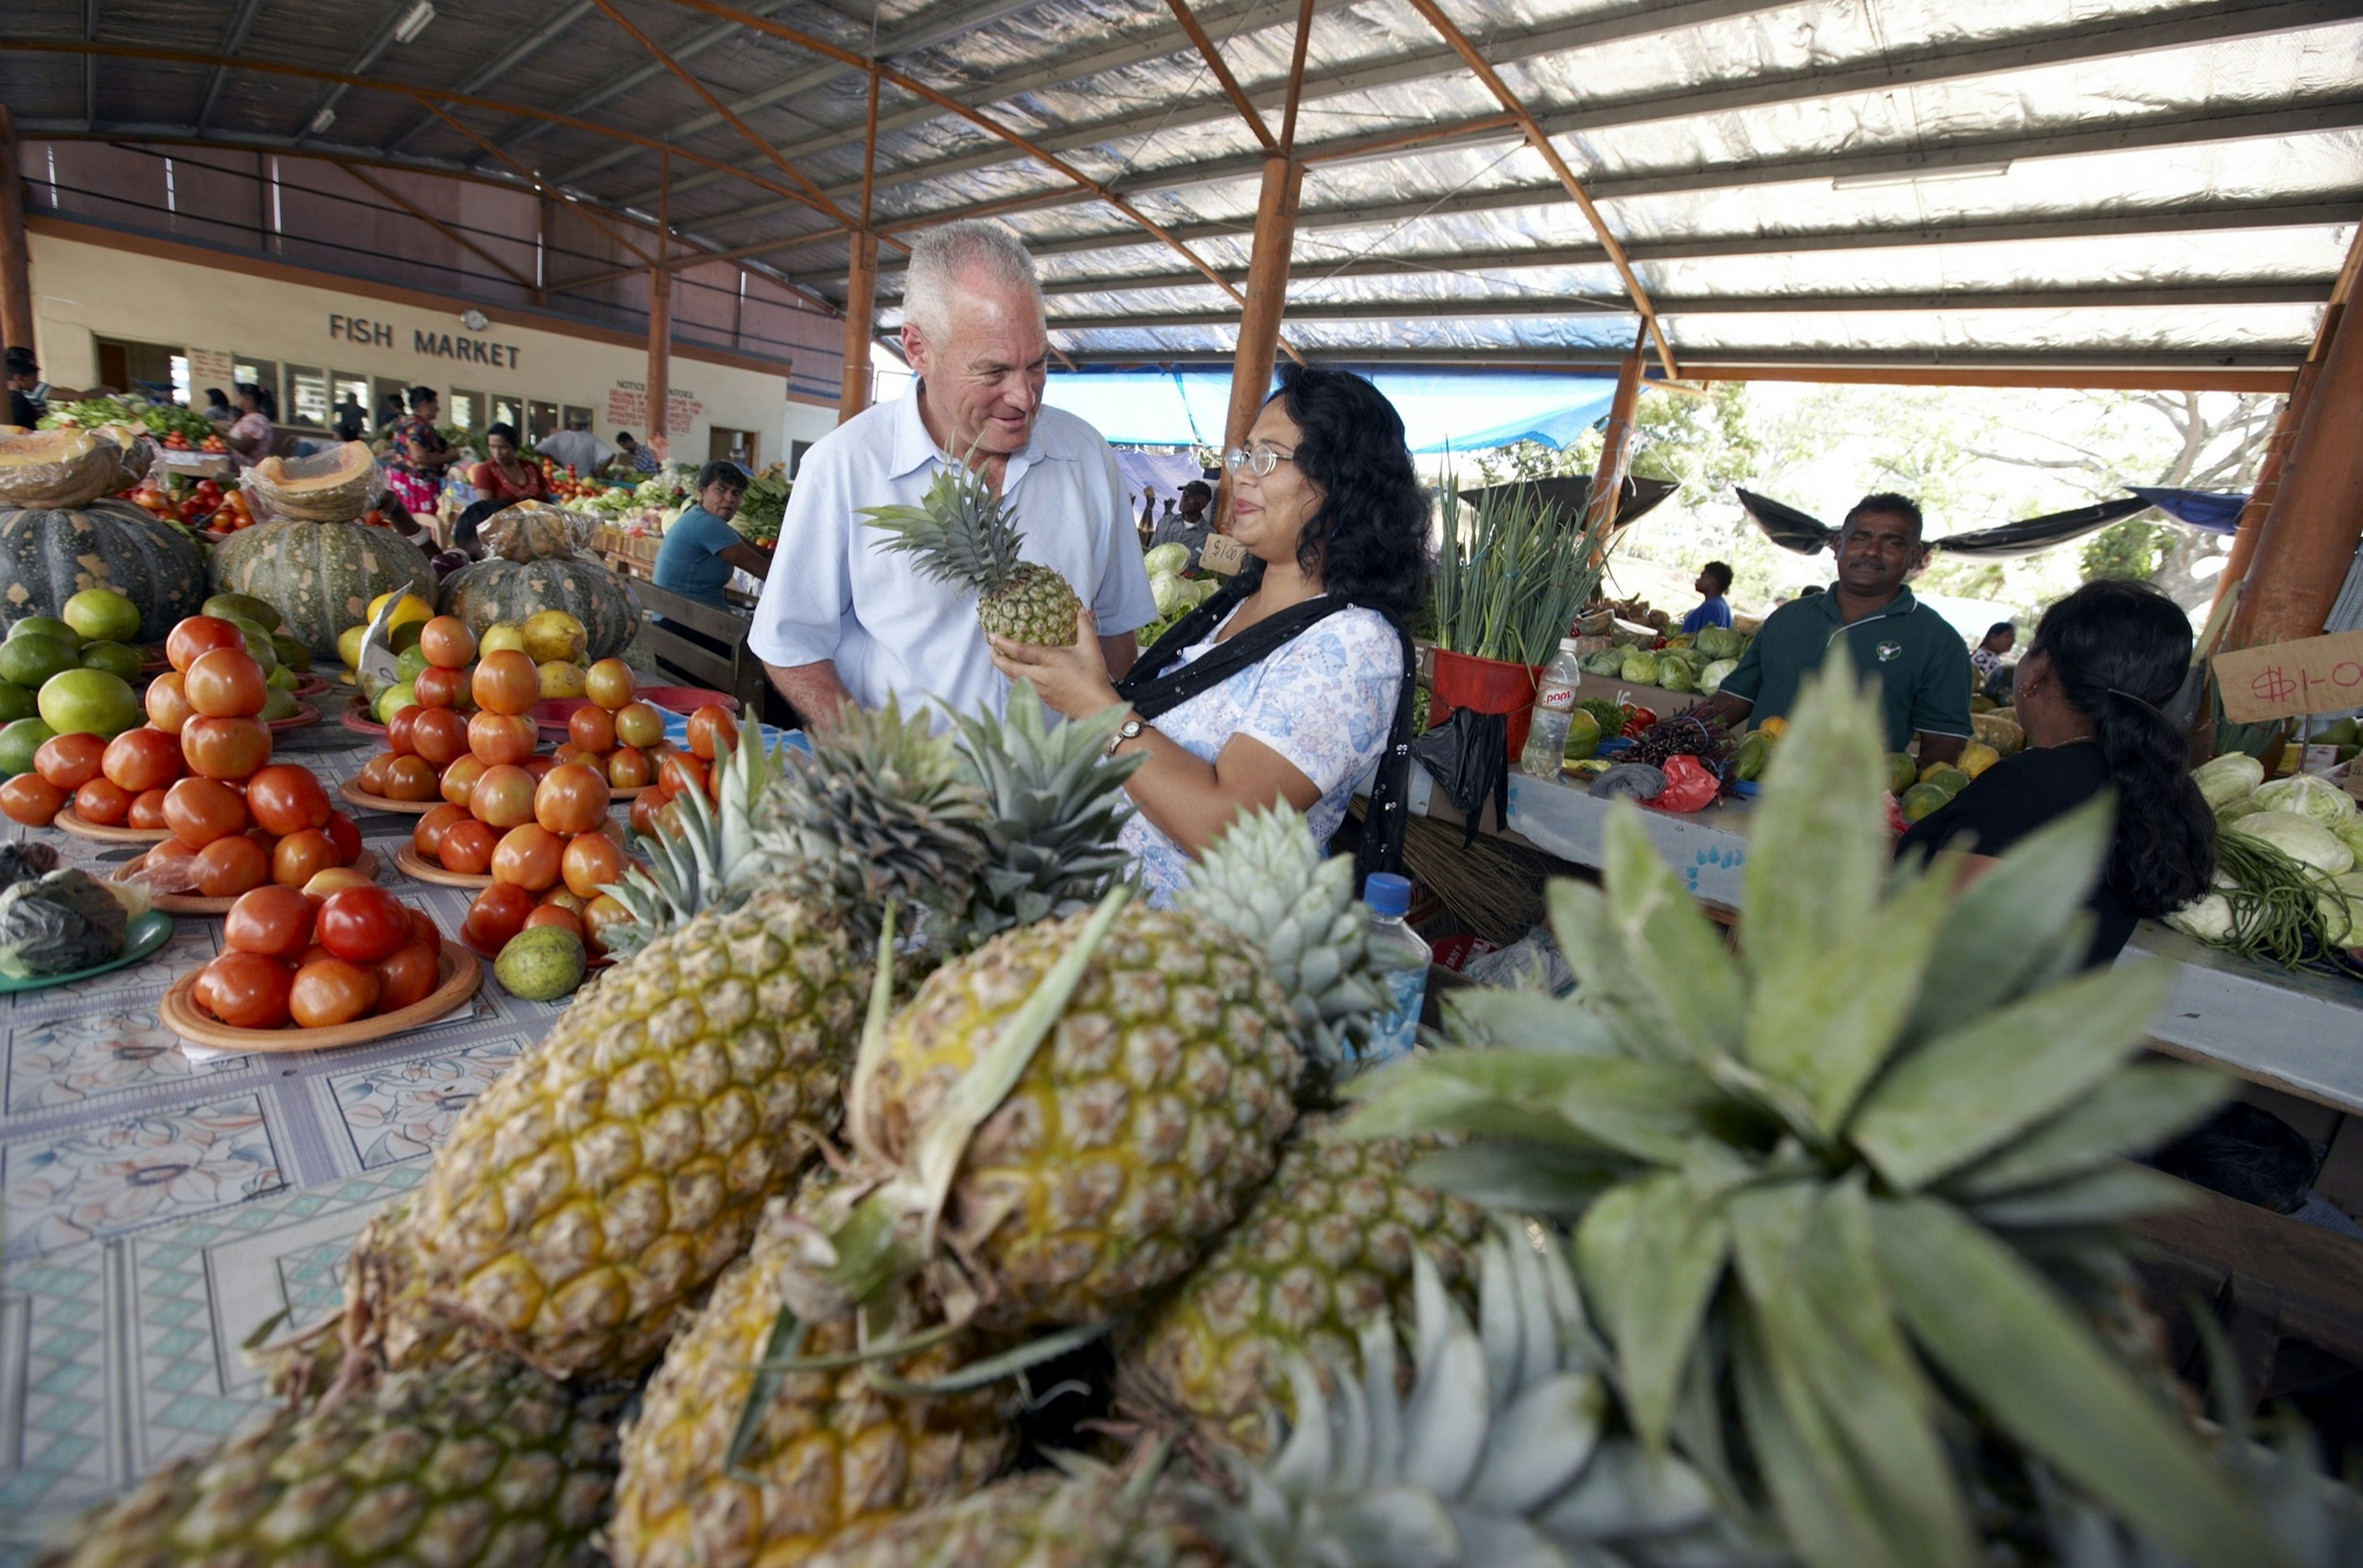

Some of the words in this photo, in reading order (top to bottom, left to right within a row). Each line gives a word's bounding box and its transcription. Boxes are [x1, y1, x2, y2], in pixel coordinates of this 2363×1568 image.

[329, 313, 393, 348] FISH
[414, 329, 521, 369] MARKET
[617, 380, 645, 391] NOTICE
[668, 388, 694, 399] NDORS
[2251, 662, 2363, 703] $1-0
